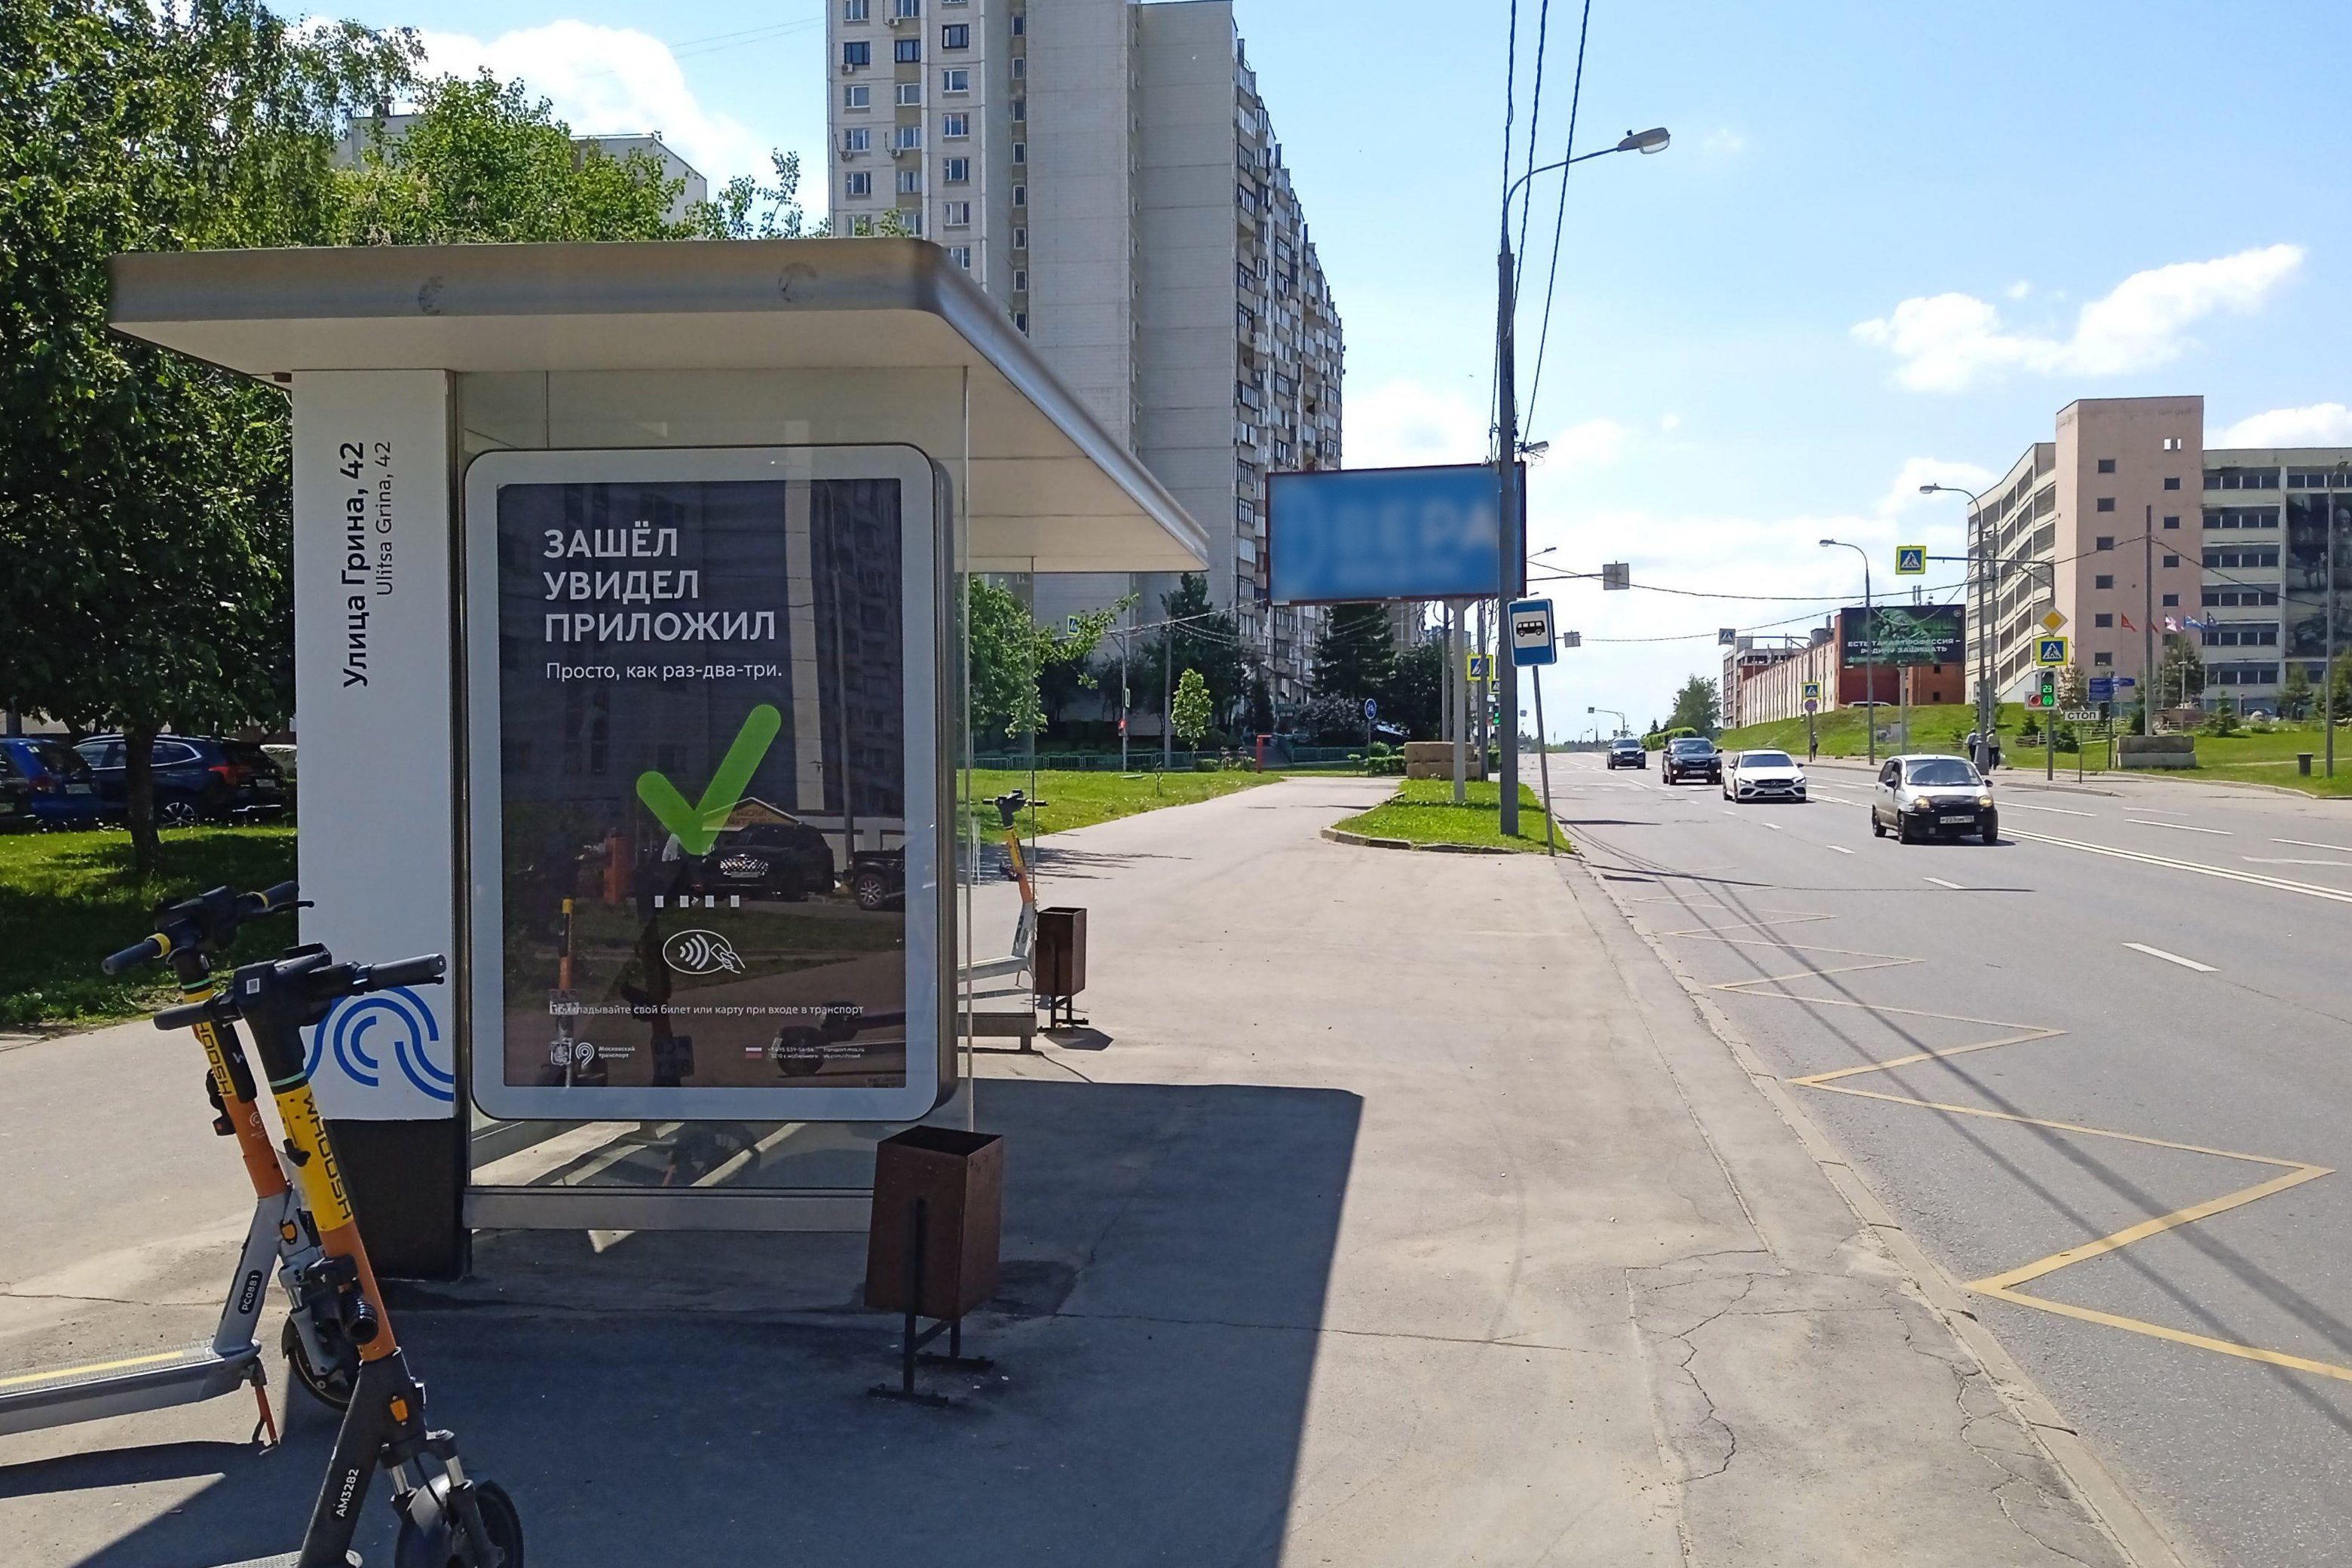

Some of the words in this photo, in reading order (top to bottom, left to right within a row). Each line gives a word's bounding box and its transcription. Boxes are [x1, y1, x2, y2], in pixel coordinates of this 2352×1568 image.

[340, 442, 364, 479] 42
[375, 441, 391, 467] 42
[375, 473, 394, 534] Grina,
[341, 488, 371, 585] Грина,
[543, 520, 678, 559] ЗАШЁЛ
[375, 541, 393, 596] Ulitsa
[543, 570, 699, 605] УВИДЕЛ
[342, 595, 370, 688] Улица
[545, 611, 775, 642] ПРИЛОЖИЛ
[547, 662, 620, 682] Просто,
[626, 664, 657, 678] как
[663, 663, 782, 681] раз-два-три.
[2042, 684, 2053, 694] 23
[2068, 712, 2096, 720] СТОП
[633, 1003, 658, 1015] свой
[660, 1004, 691, 1015] билет
[694, 1006, 712, 1014] или
[715, 1006, 744, 1016] карту
[746, 1006, 766, 1016] при
[768, 1006, 798, 1016] входе
[801, 1006, 807, 1014] в
[810, 1006, 864, 1016] транспорт
[200, 1023, 232, 1095] HOOSH
[303, 1092, 351, 1220] WHOOSH
[335, 1468, 360, 1517] AM3282
